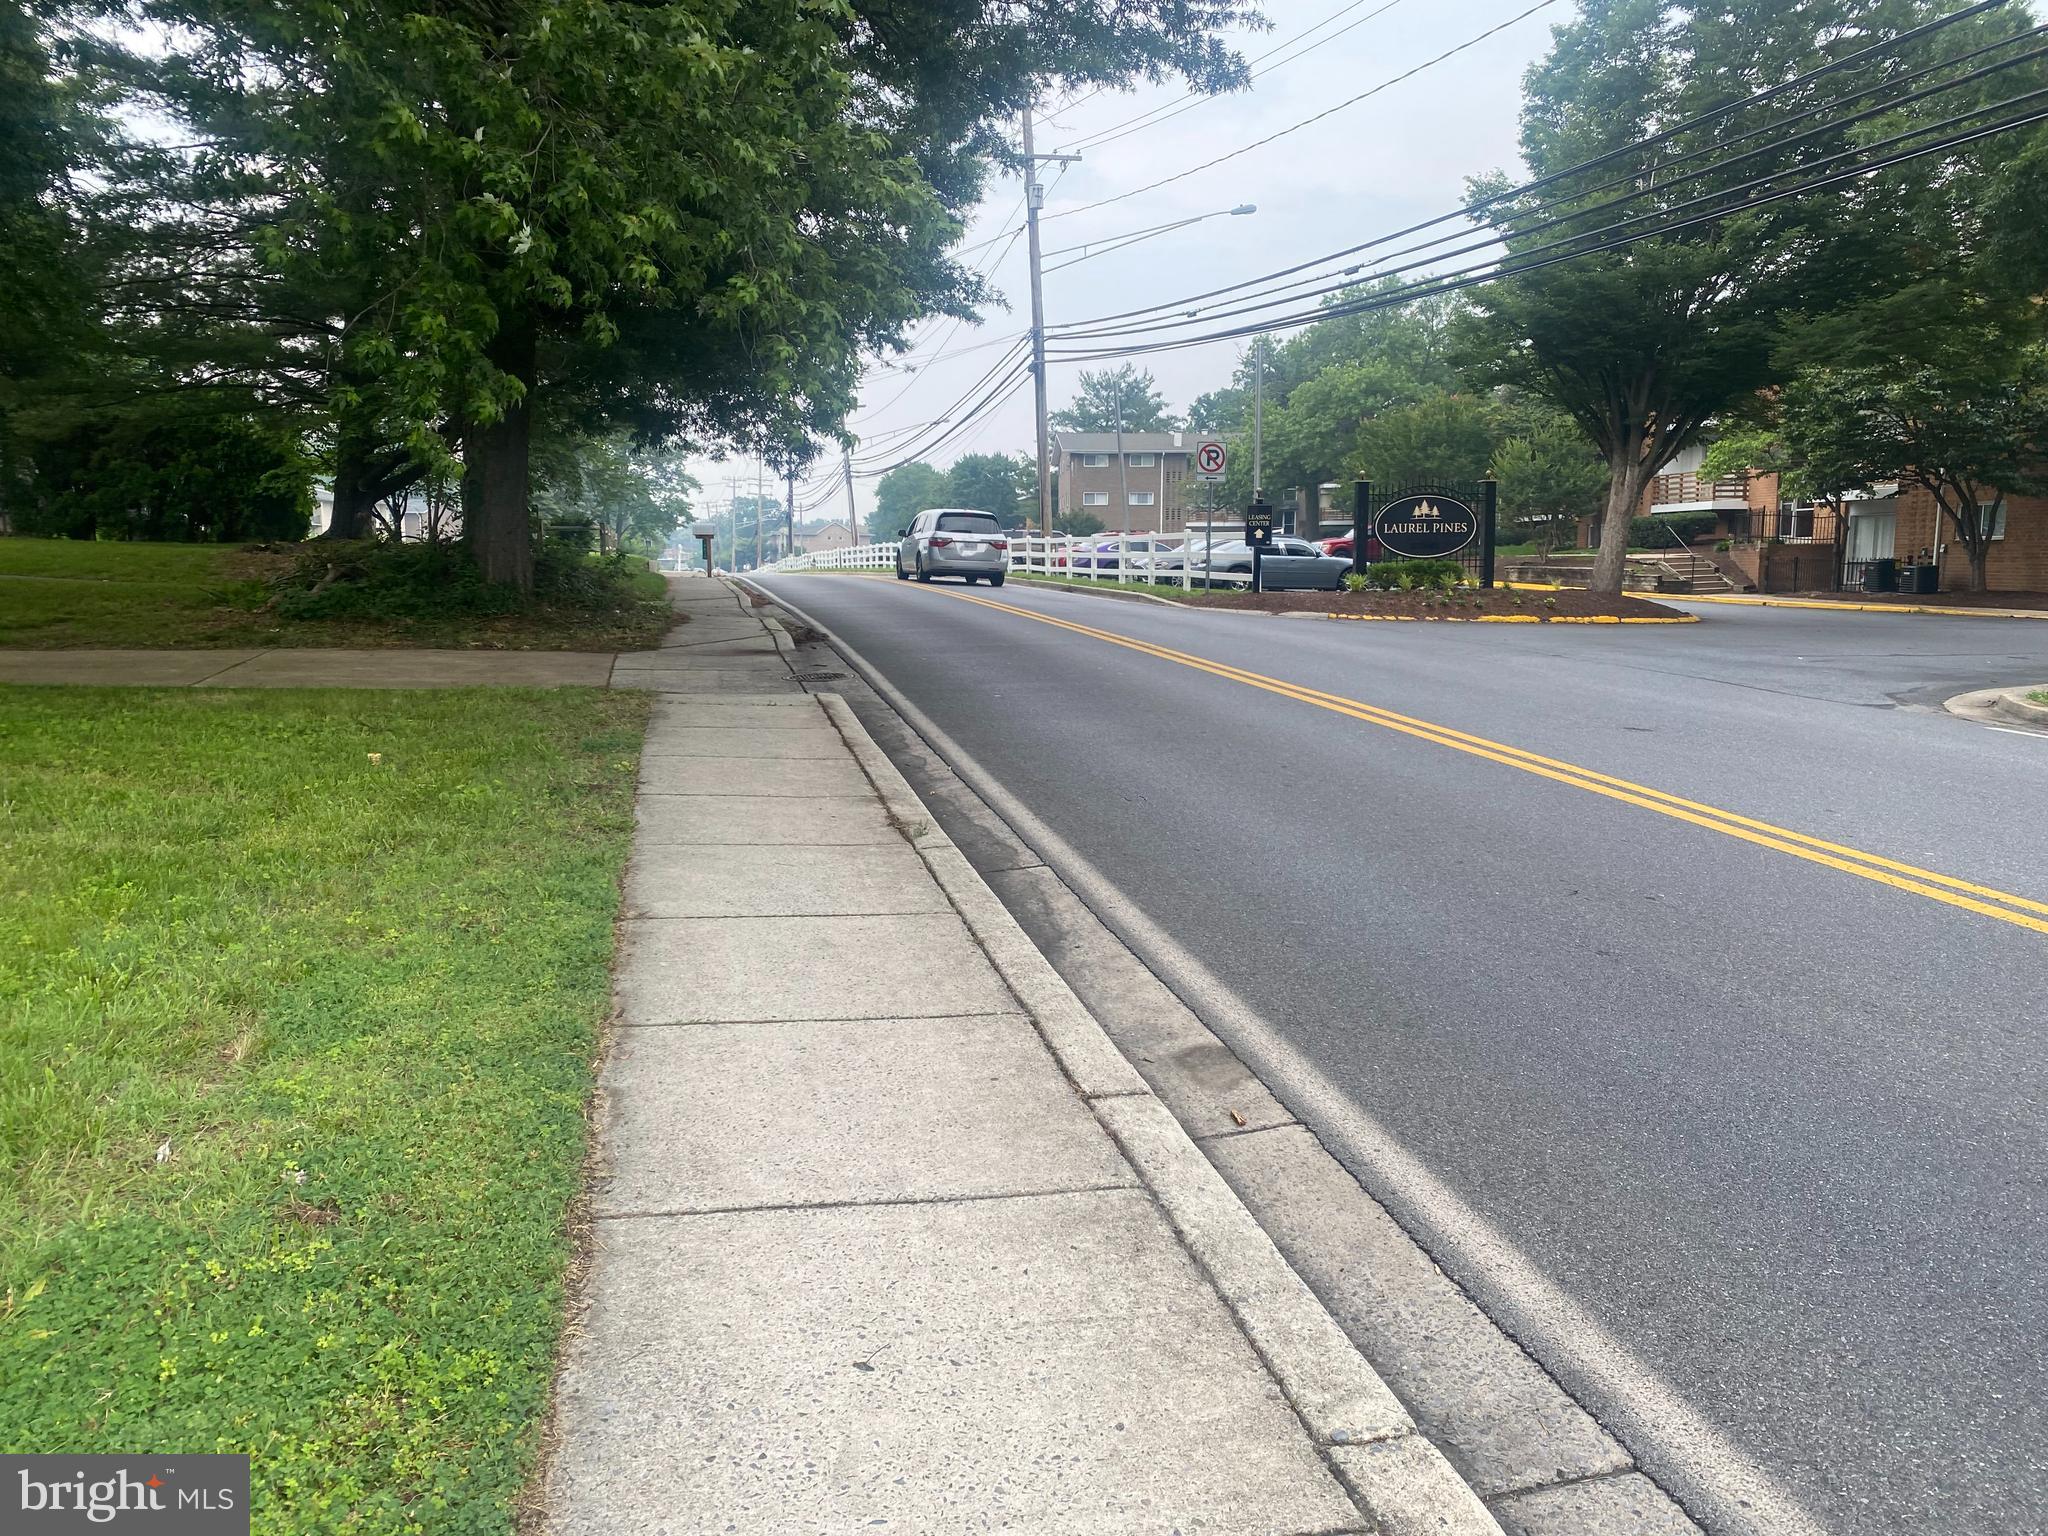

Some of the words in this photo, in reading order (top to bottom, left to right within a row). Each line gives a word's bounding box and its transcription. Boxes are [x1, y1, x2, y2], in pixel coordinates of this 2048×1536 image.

[1206, 449, 1220, 466] P
[1384, 523, 1430, 534] LAUREL
[1433, 522, 1468, 533] PINES
